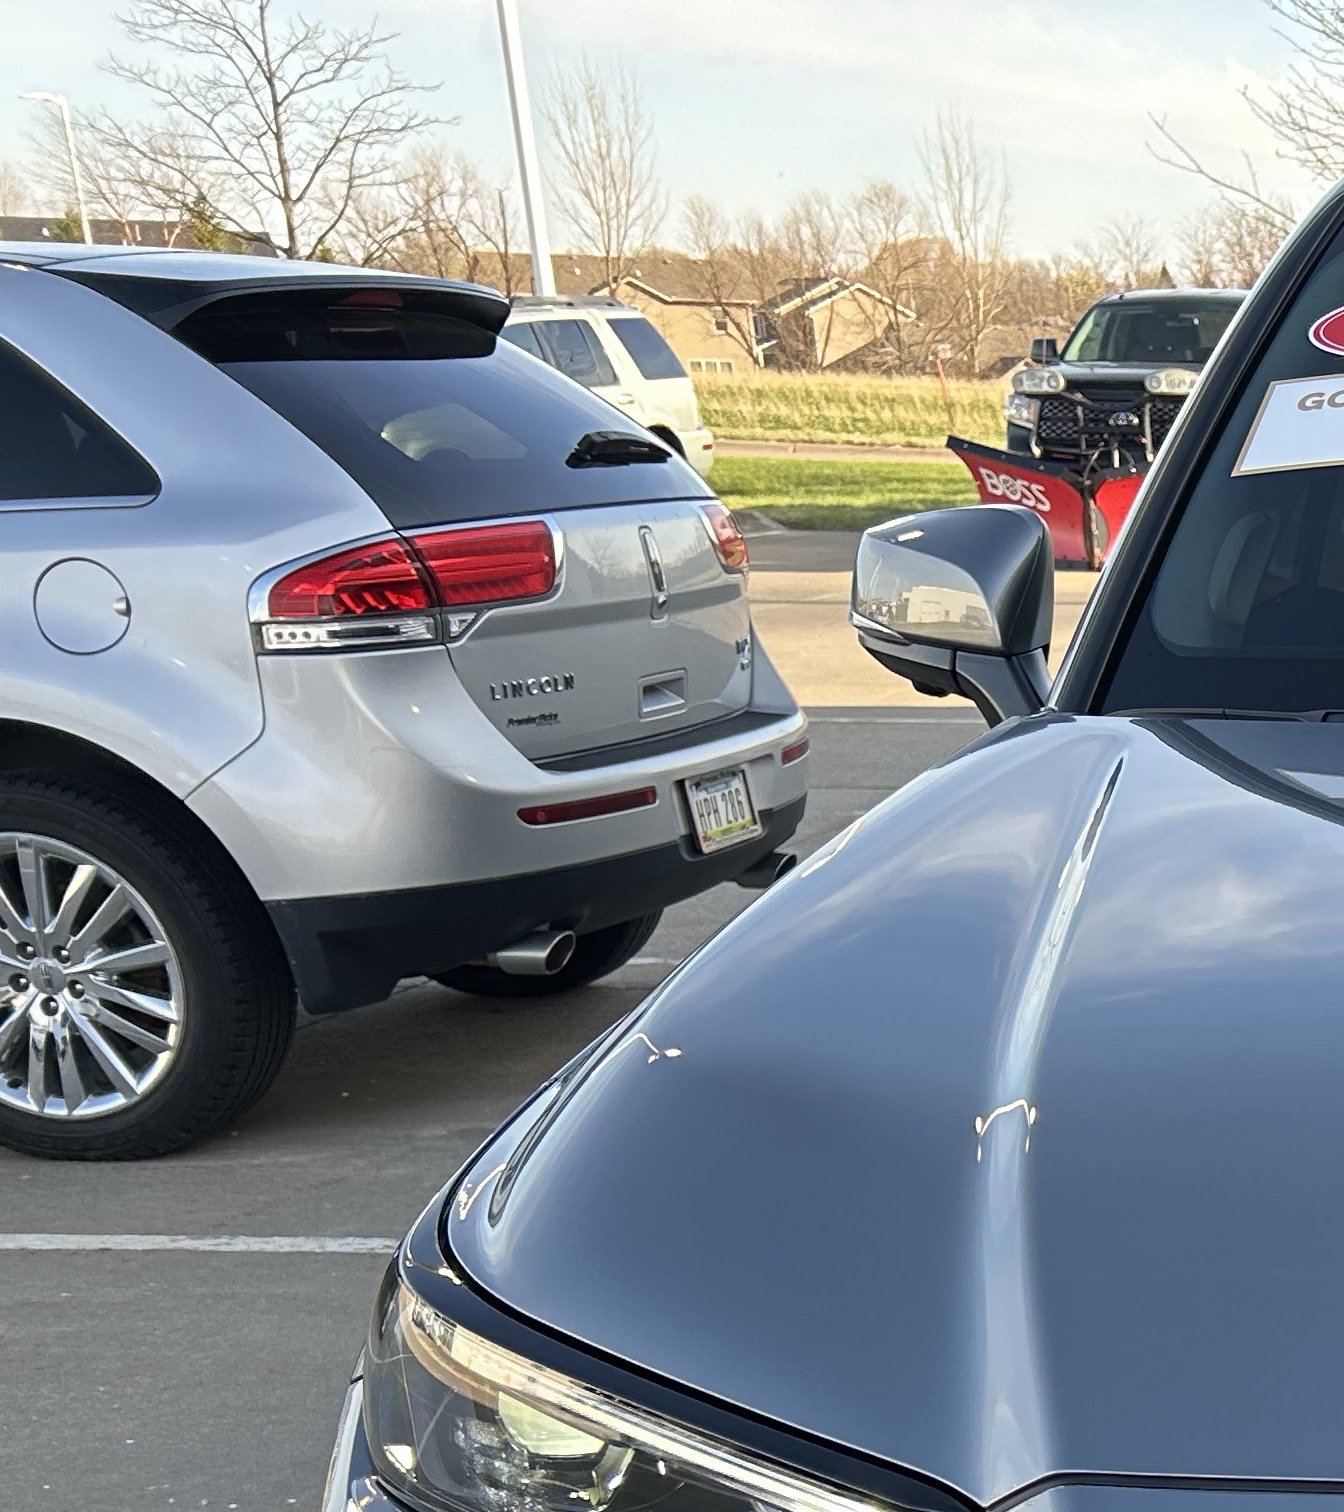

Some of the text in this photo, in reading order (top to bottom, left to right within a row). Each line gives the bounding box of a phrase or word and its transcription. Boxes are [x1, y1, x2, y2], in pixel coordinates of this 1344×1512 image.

[977, 465, 1052, 512] BOSS
[489, 671, 575, 701] LINCOLN
[721, 787, 746, 825] 286
